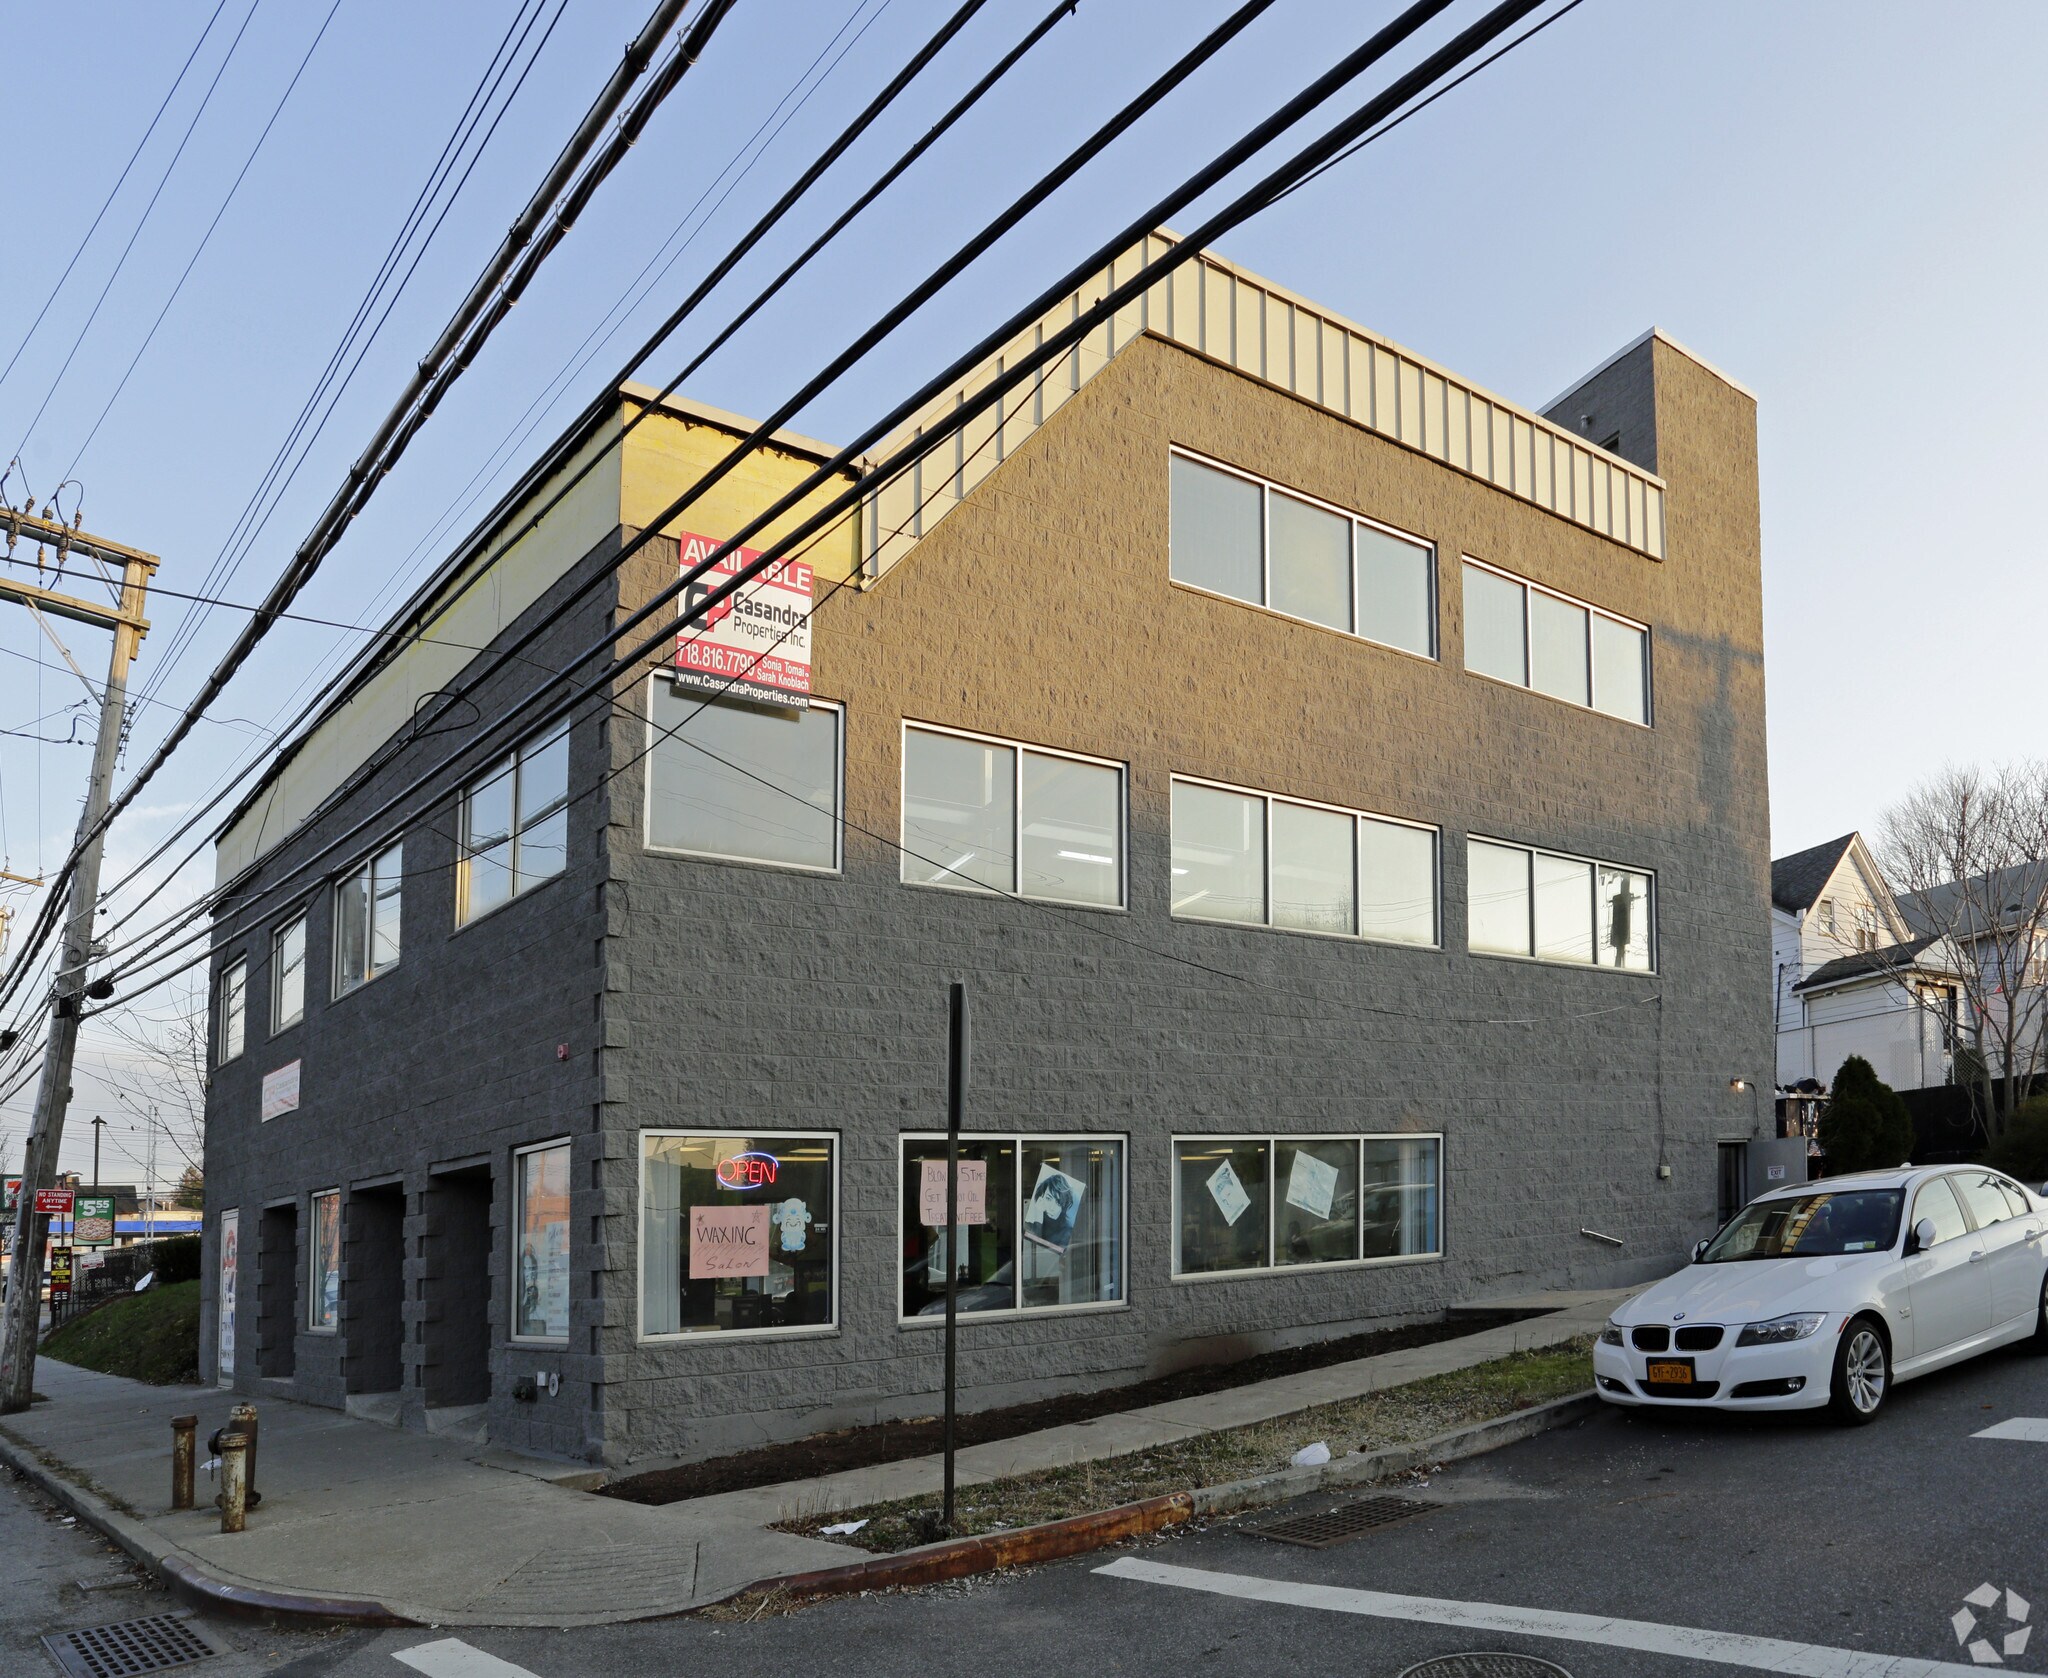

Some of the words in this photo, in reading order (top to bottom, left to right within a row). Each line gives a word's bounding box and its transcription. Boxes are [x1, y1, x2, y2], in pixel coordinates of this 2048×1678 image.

[733, 591, 808, 630] Casandra
[734, 616, 787, 642] Properties
[790, 630, 806, 648] Inc.
[678, 641, 756, 677] 718.816.7799
[762, 656, 782, 672] Sonia
[785, 661, 805, 677] Tomai
[757, 668, 776, 684] Sarah
[678, 672, 808, 707] www.CasandraProperties.com
[717, 1158, 776, 1184] OPEN
[961, 1167, 970, 1181] 5
[925, 1188, 940, 1202] GET
[697, 1226, 756, 1246] WAXING
